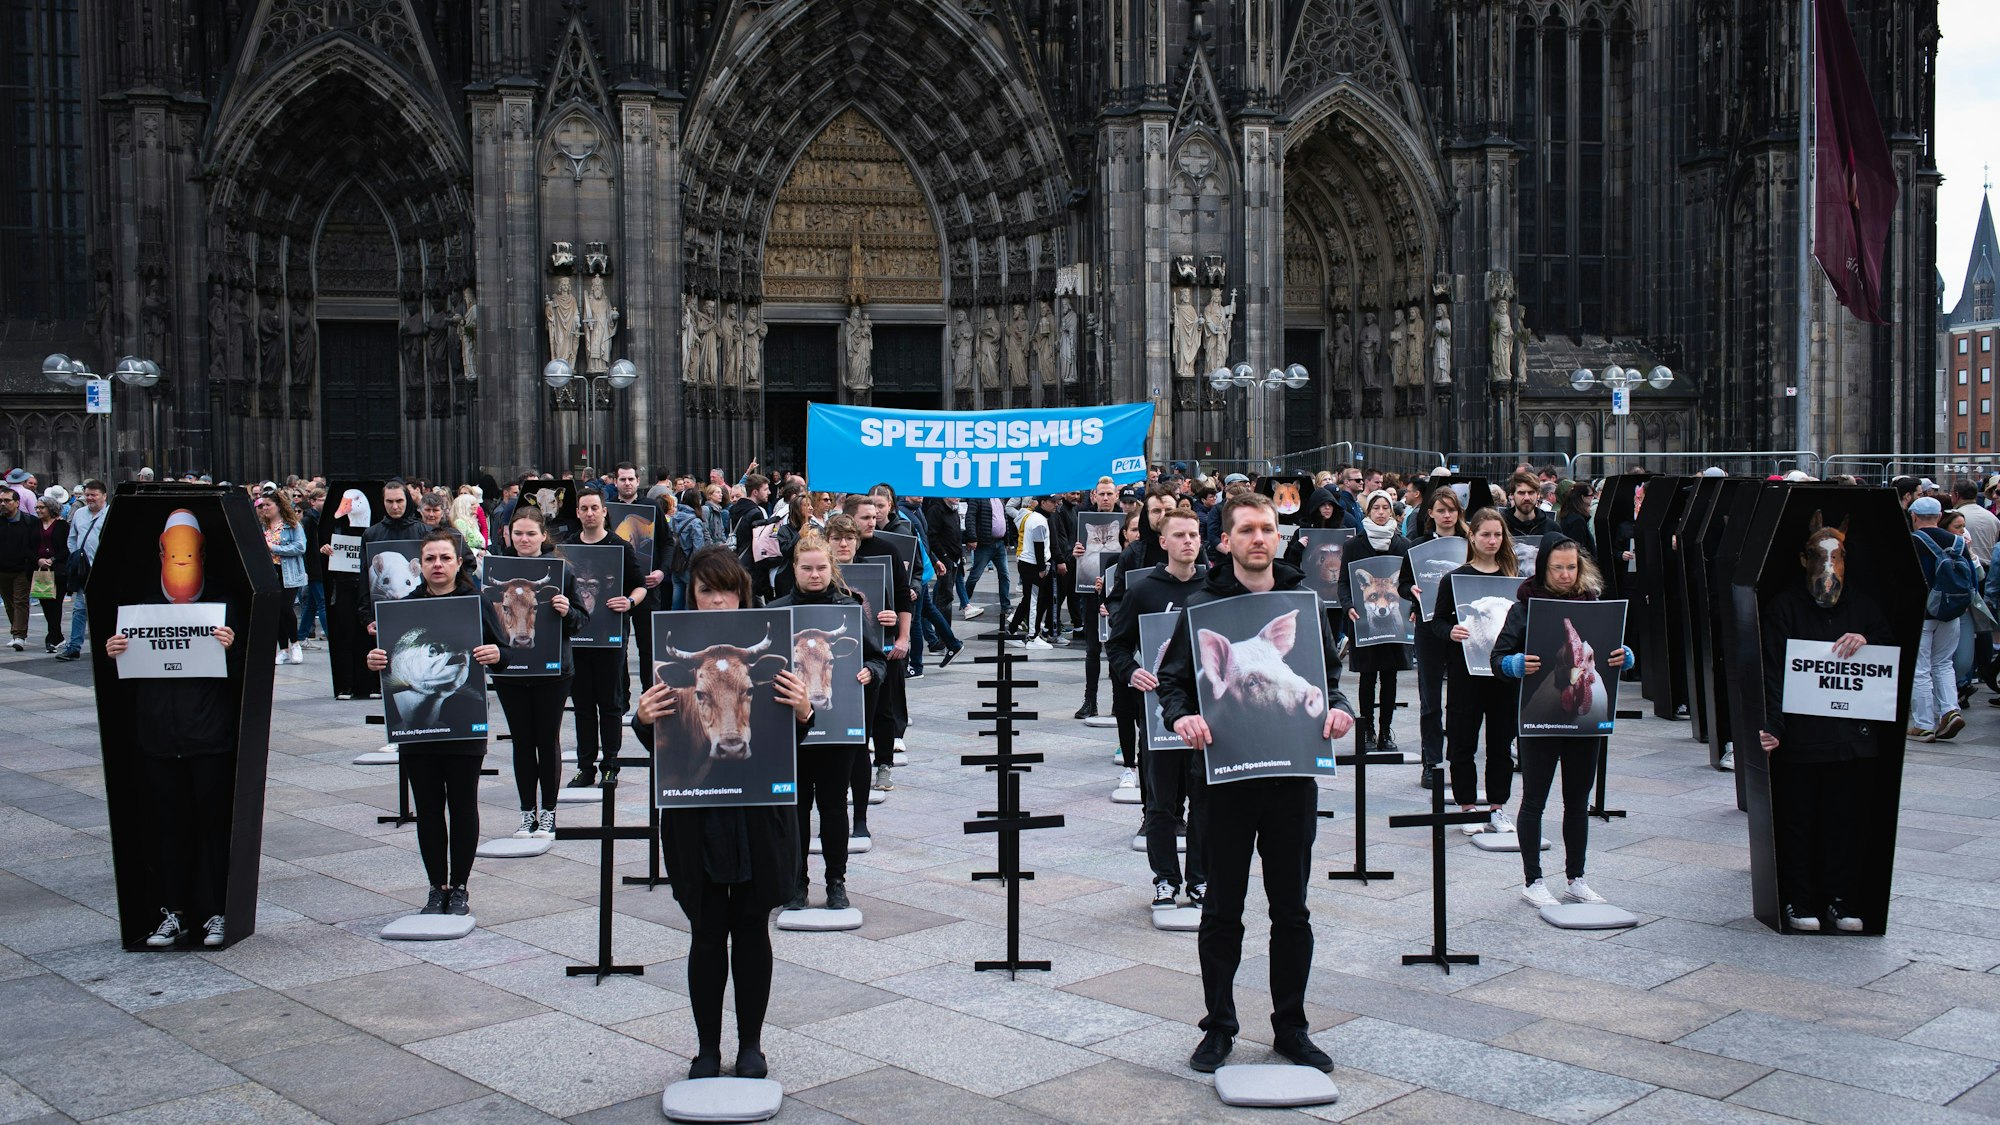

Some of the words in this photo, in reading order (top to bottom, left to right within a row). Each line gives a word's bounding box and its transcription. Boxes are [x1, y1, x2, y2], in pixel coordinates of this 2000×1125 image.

[861, 417, 1104, 449] SPEZIESISMUS
[916, 450, 1048, 488] TÖTET
[333, 544, 361, 552] SPECIE
[121, 626, 218, 639] SPEZIESISMUS
[149, 638, 191, 650] TÖTET
[1792, 658, 1893, 678] SPECIESISM
[1818, 675, 1864, 691] KILLS
[391, 727, 451, 737] PETA.de/Speziesismus
[1214, 760, 1292, 775] PETA.de/Speziesismus
[662, 787, 743, 797] PETA.de/Speziesismus
